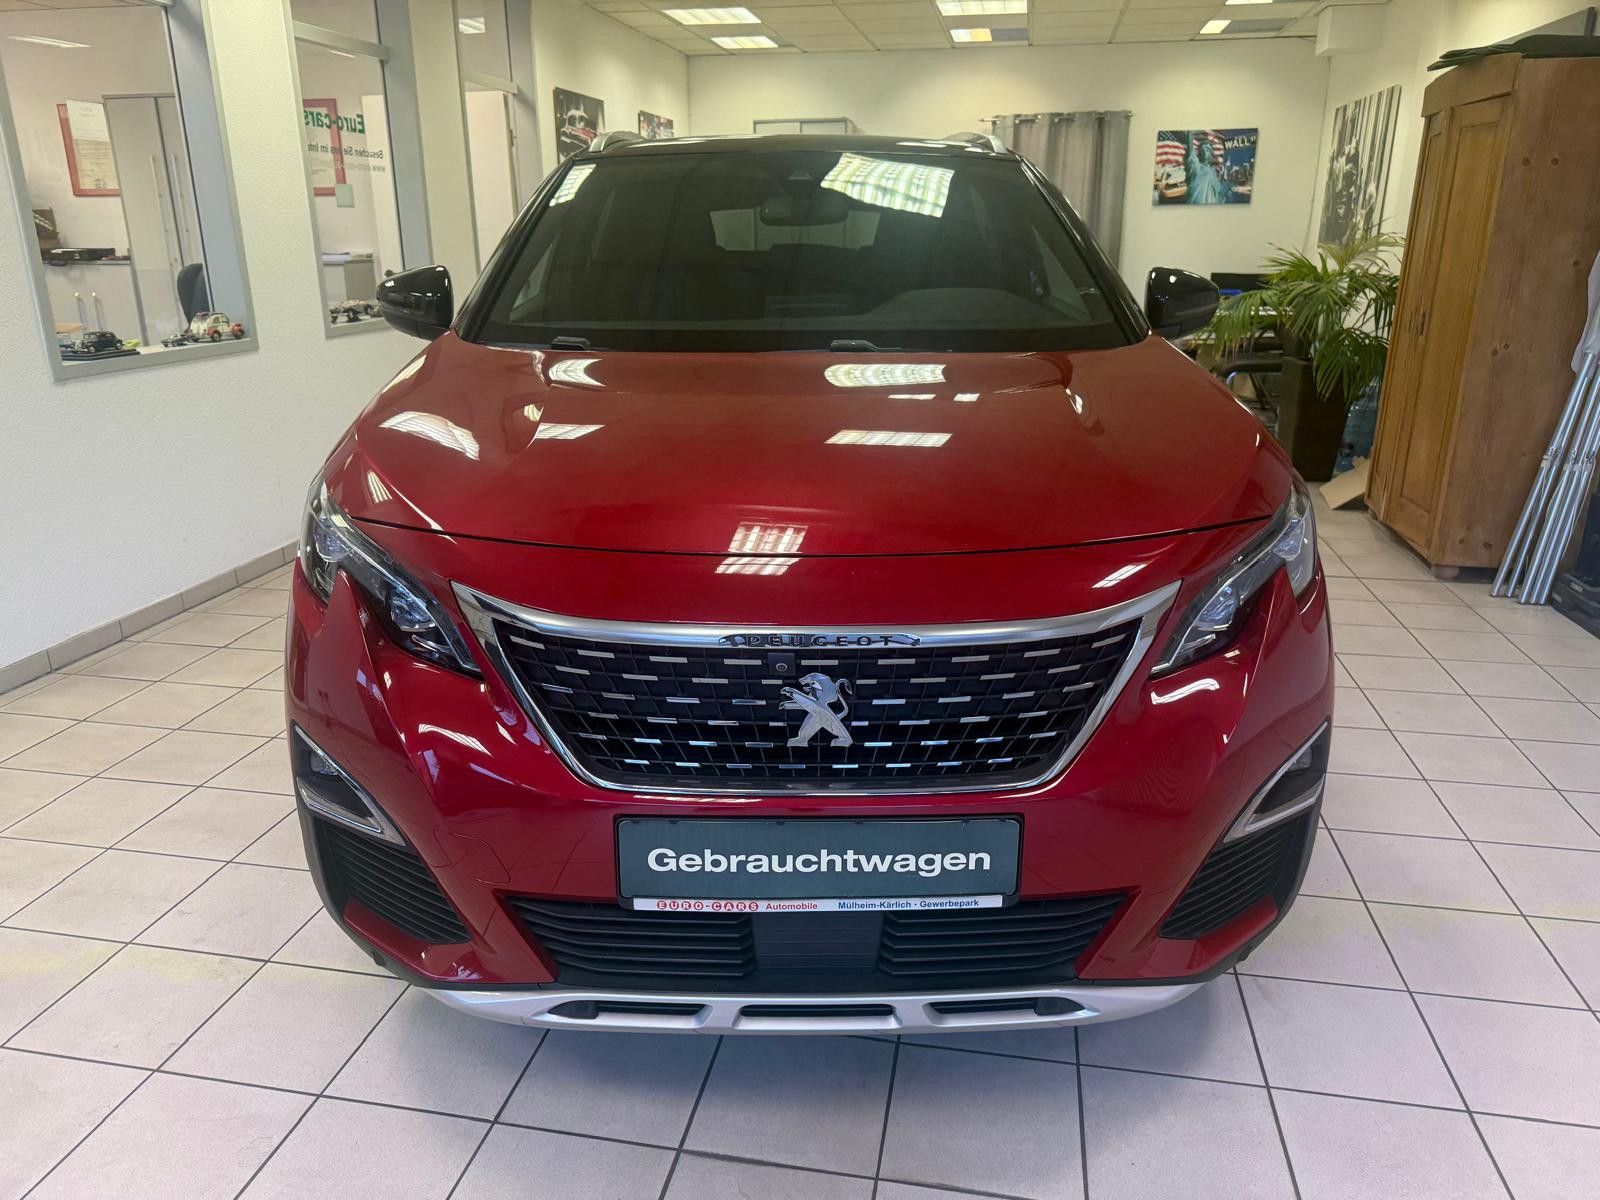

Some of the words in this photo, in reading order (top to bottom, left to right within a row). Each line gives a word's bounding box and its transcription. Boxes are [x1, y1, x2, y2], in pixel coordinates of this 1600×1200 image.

[1225, 136, 1250, 149] WALL
[748, 635, 893, 647] PEUGEOT
[646, 847, 992, 878] Gebrauchtwagen
[656, 900, 760, 912] EURO-CARS
[765, 901, 818, 911] Automobile
[838, 900, 912, 910] Mülheim-Kärlich
[919, 898, 980, 910] Gewerbepark
